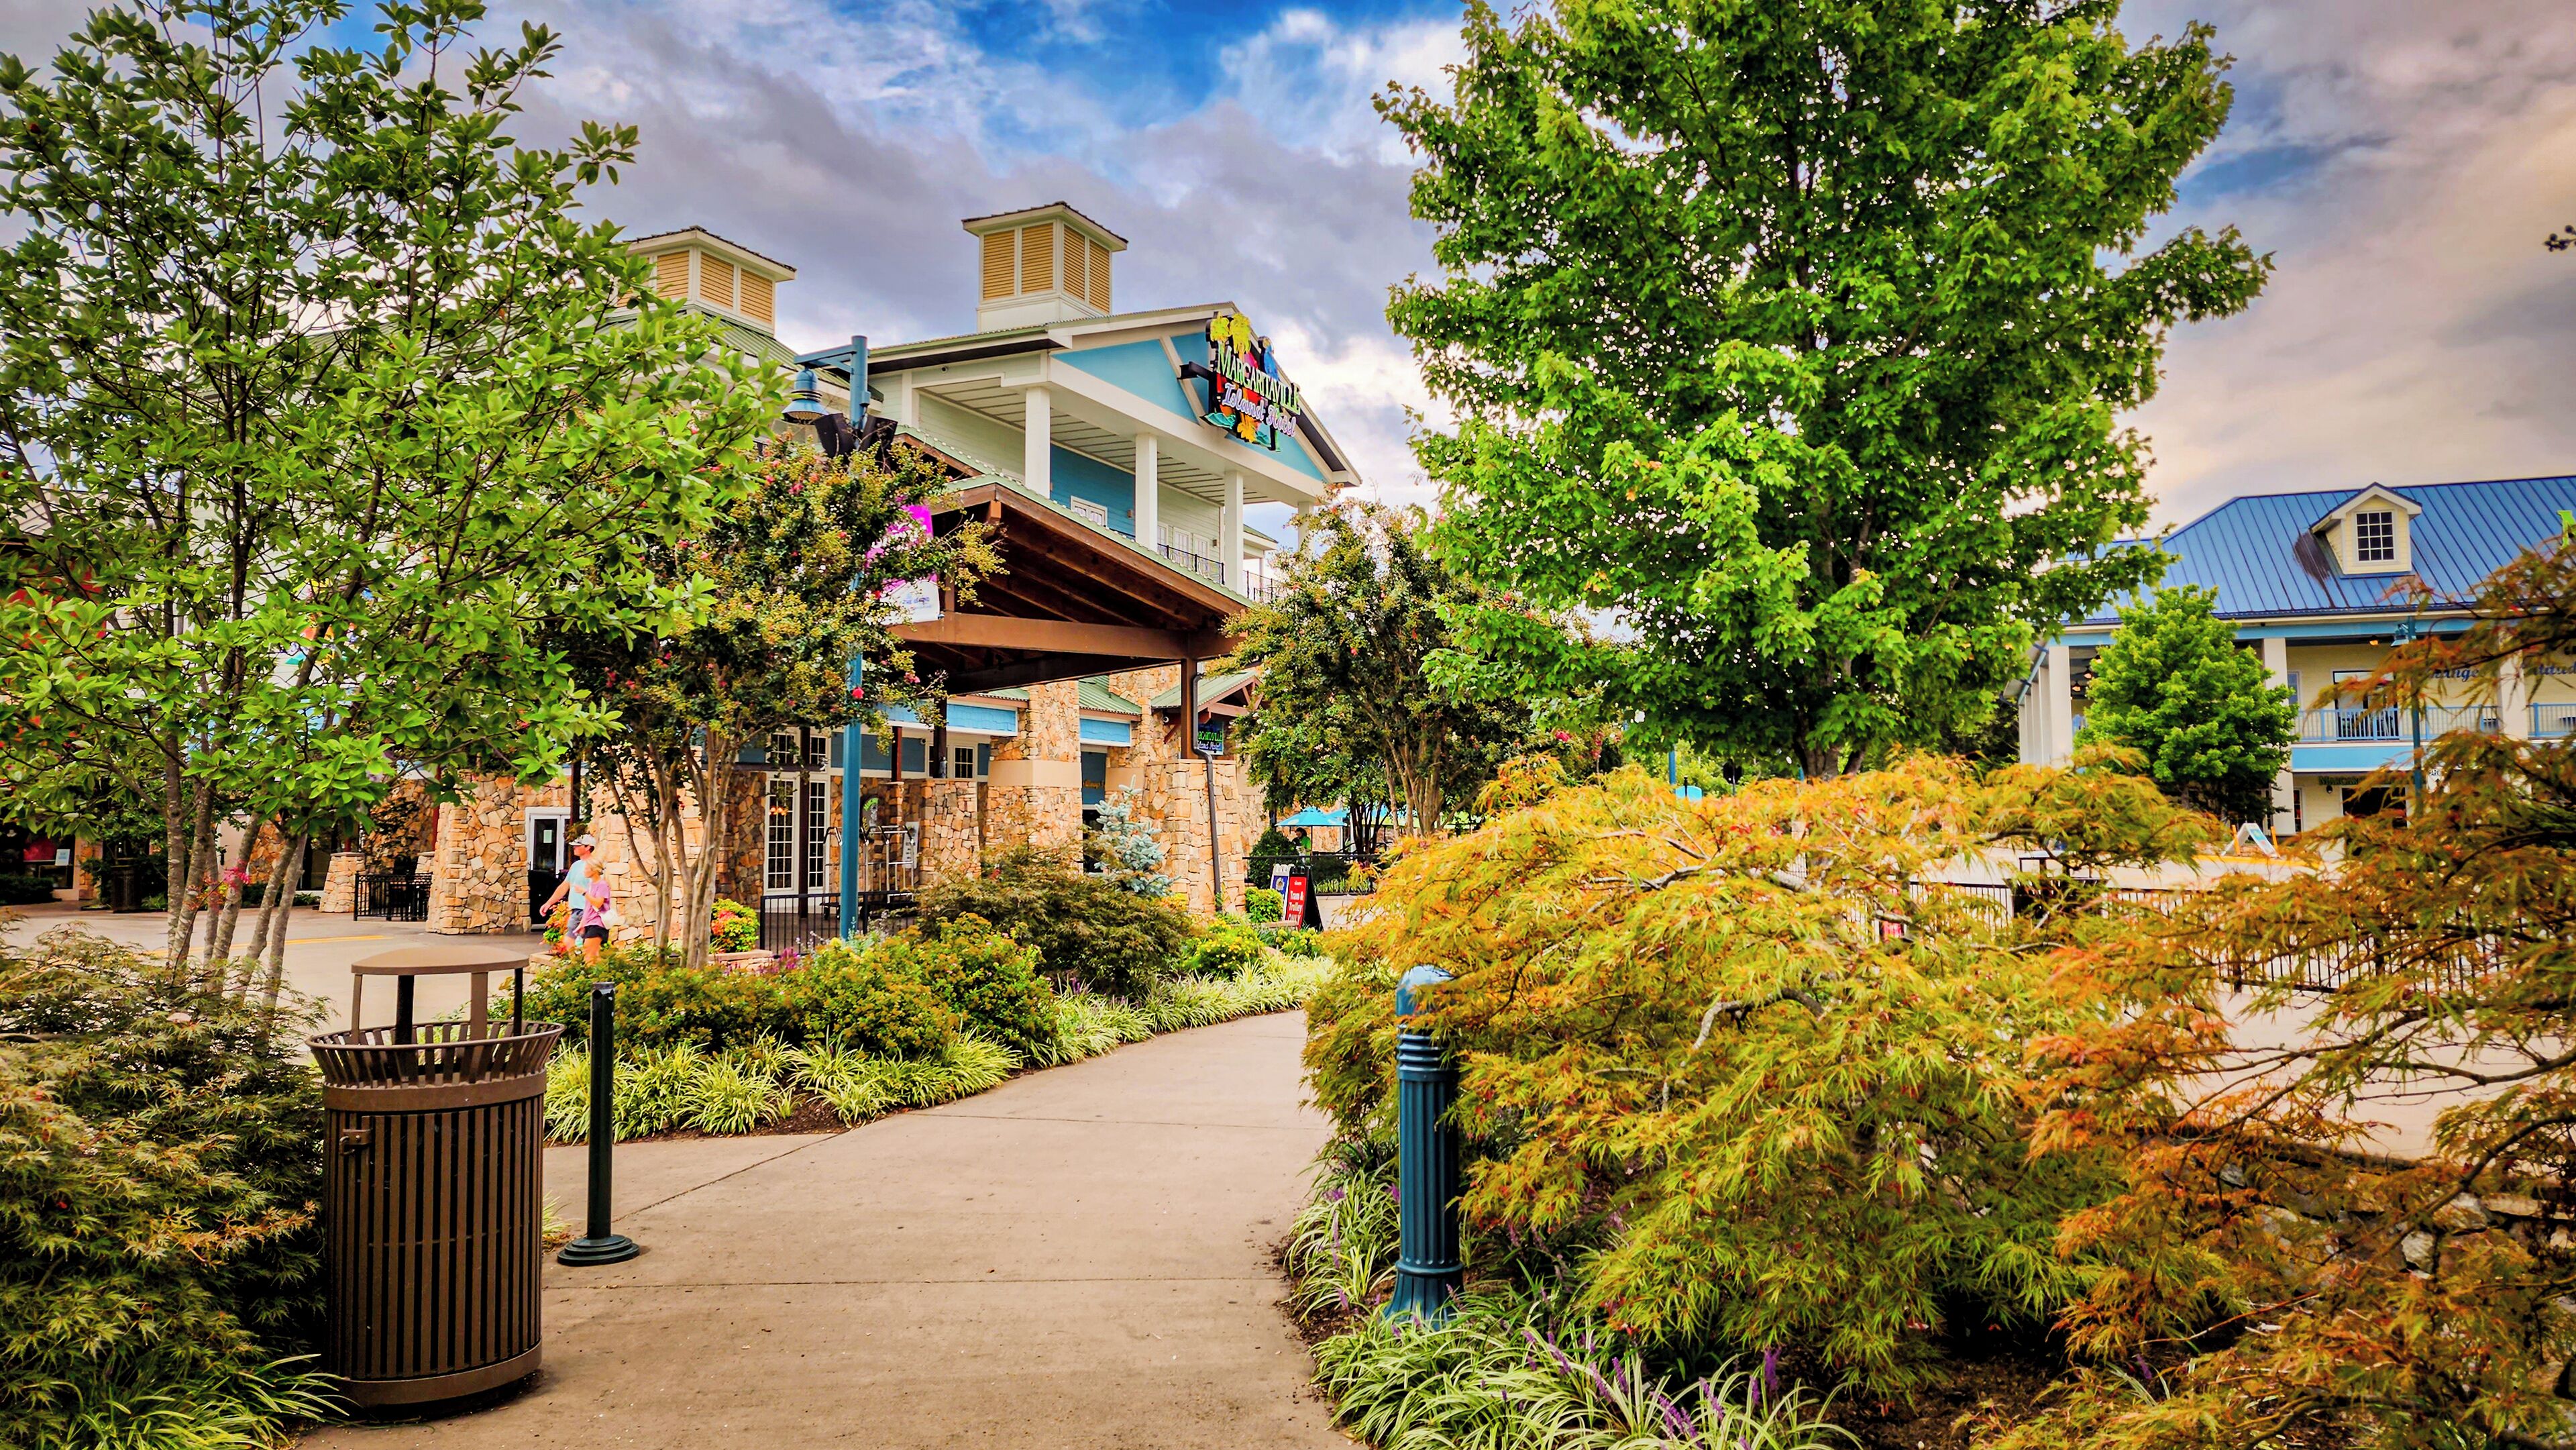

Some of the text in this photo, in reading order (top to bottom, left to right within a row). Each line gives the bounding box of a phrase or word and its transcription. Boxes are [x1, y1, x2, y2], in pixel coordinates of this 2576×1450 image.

[1216, 341, 1301, 415] MARGARITAVILLE
[1222, 382, 1297, 437] Island Hotel
[1289, 902, 1303, 914] Trolley
[1290, 890, 1300, 900] Tram
